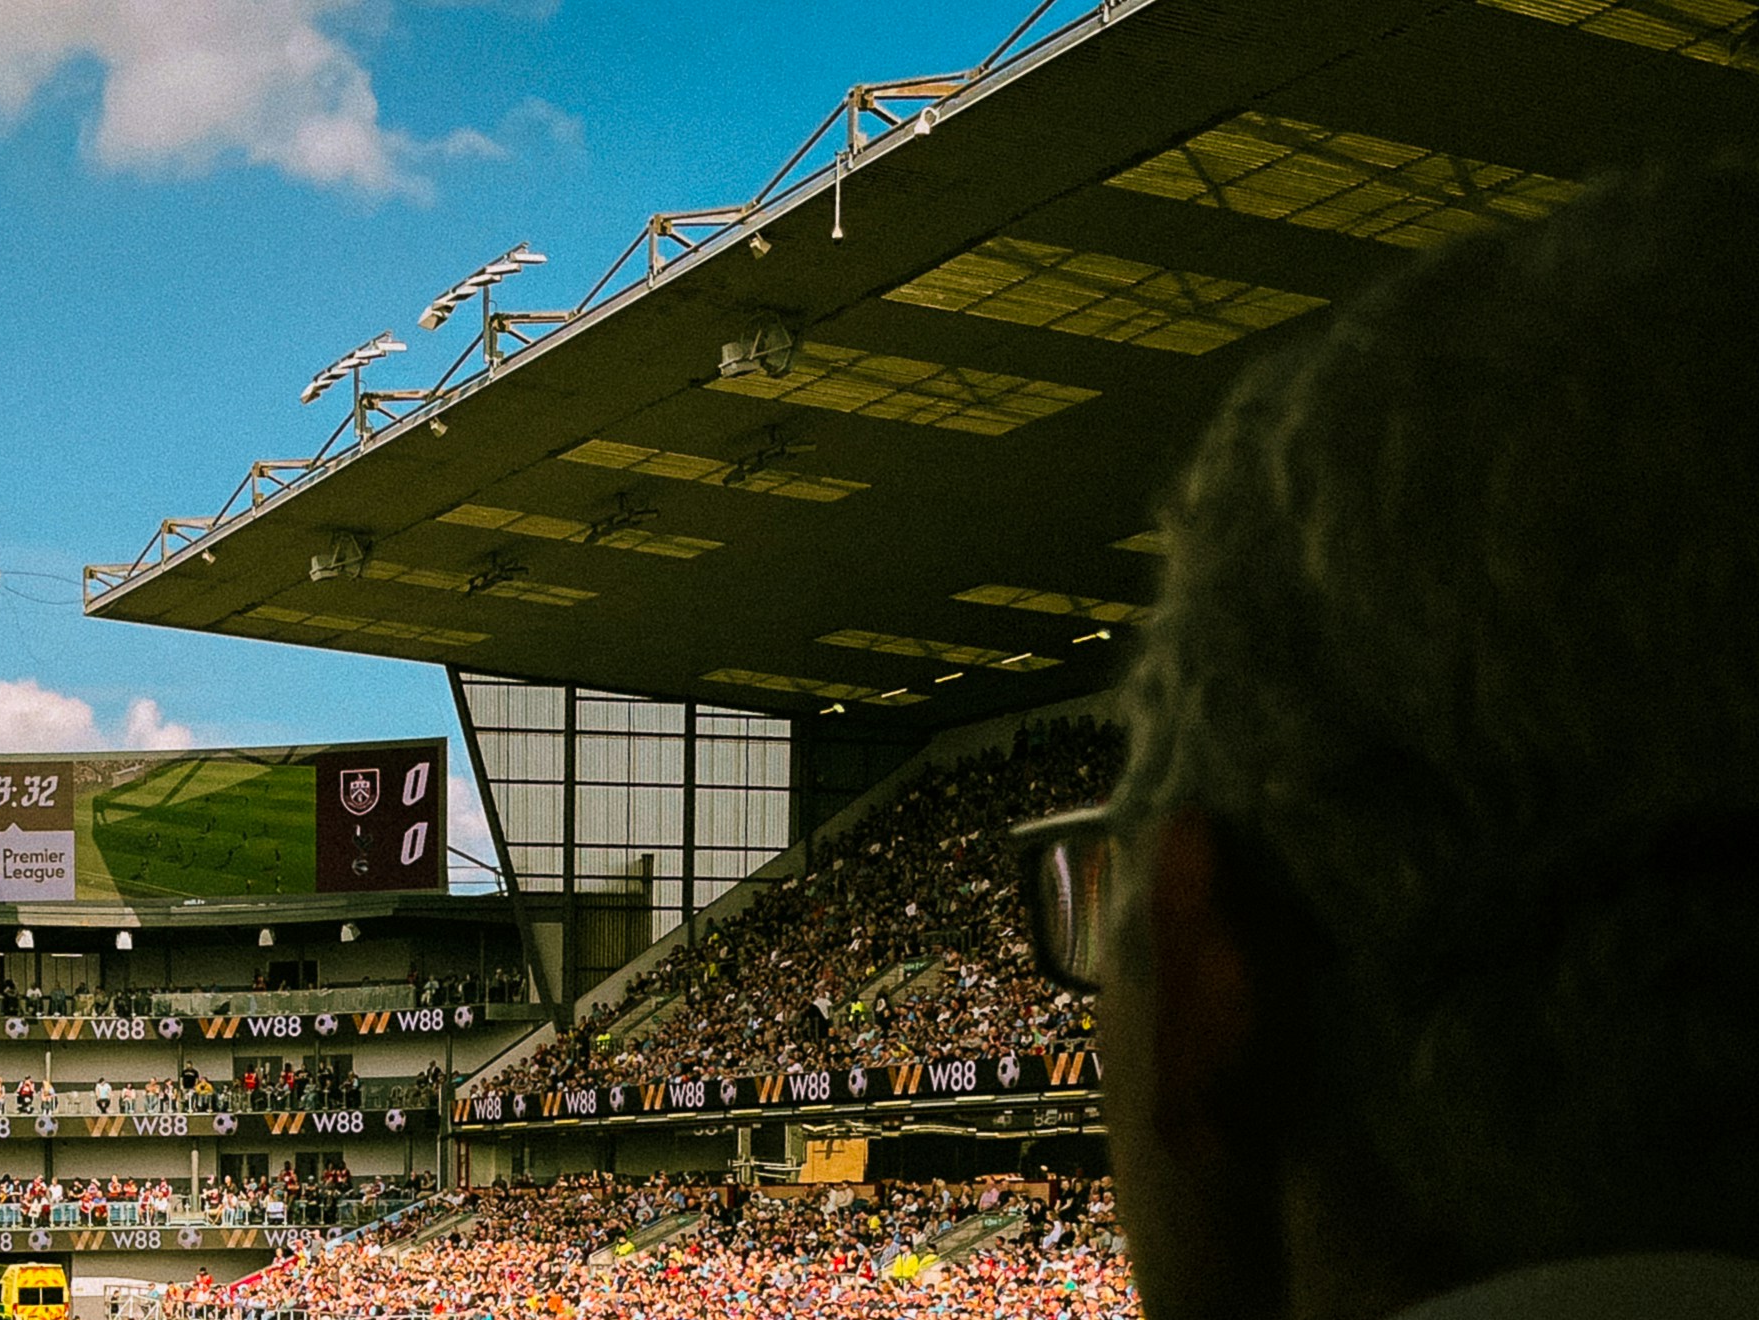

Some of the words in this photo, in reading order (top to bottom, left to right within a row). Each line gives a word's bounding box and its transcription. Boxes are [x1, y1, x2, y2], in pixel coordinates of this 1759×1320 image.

[402, 762, 430, 806] 0
[401, 822, 428, 865] 0
[3, 848, 65, 864] Premier
[3, 865, 65, 883] League
[91, 1018, 145, 1041] W88
[247, 1016, 302, 1037] W88
[397, 1009, 444, 1032] W88
[789, 1071, 830, 1101] W88
[928, 1060, 977, 1092] W88
[565, 1088, 597, 1115] W88
[669, 1080, 705, 1108] W88
[474, 1096, 502, 1120] W88
[133, 1116, 188, 1137] W88
[312, 1111, 364, 1133] W88
[111, 1229, 162, 1250] W88
